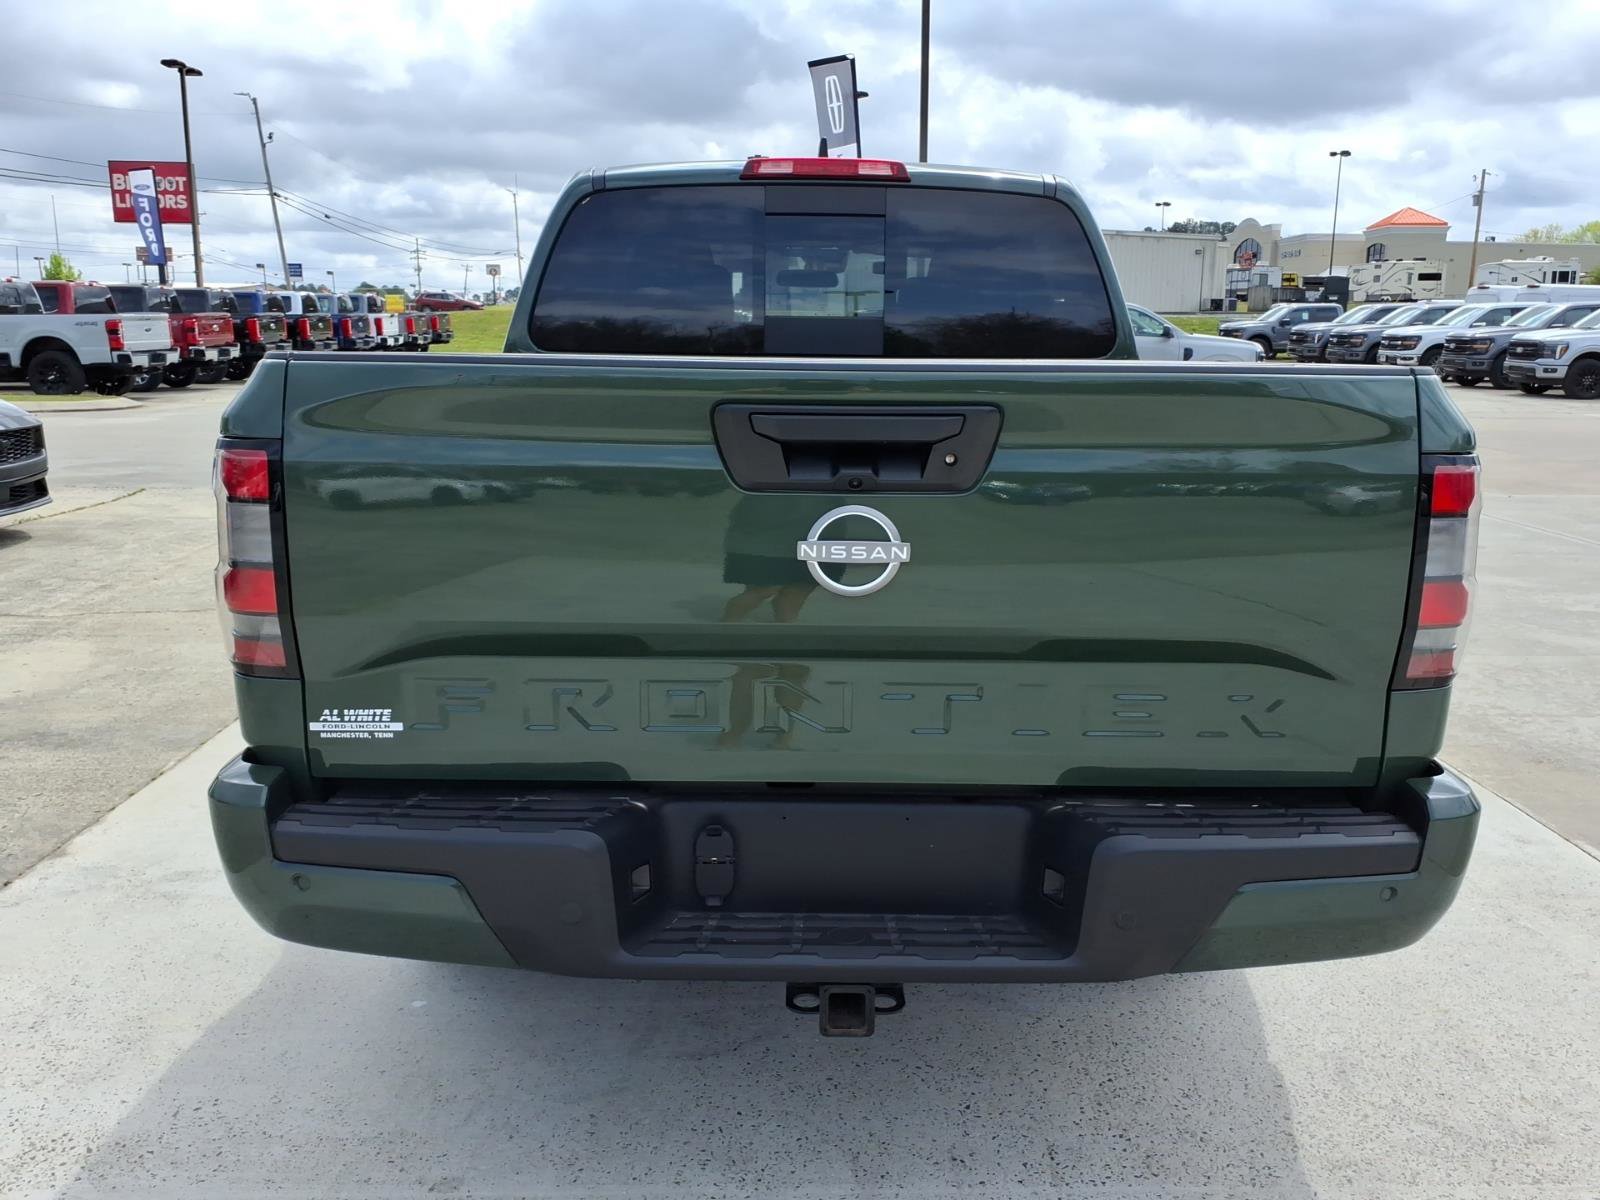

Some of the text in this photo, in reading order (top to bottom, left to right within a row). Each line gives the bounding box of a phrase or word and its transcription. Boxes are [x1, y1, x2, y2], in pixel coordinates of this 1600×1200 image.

[112, 173, 187, 192] BIOOT
[800, 544, 908, 560] NISSAN
[320, 708, 392, 722] AL WHITE
[410, 677, 1288, 738] FRONTIER
